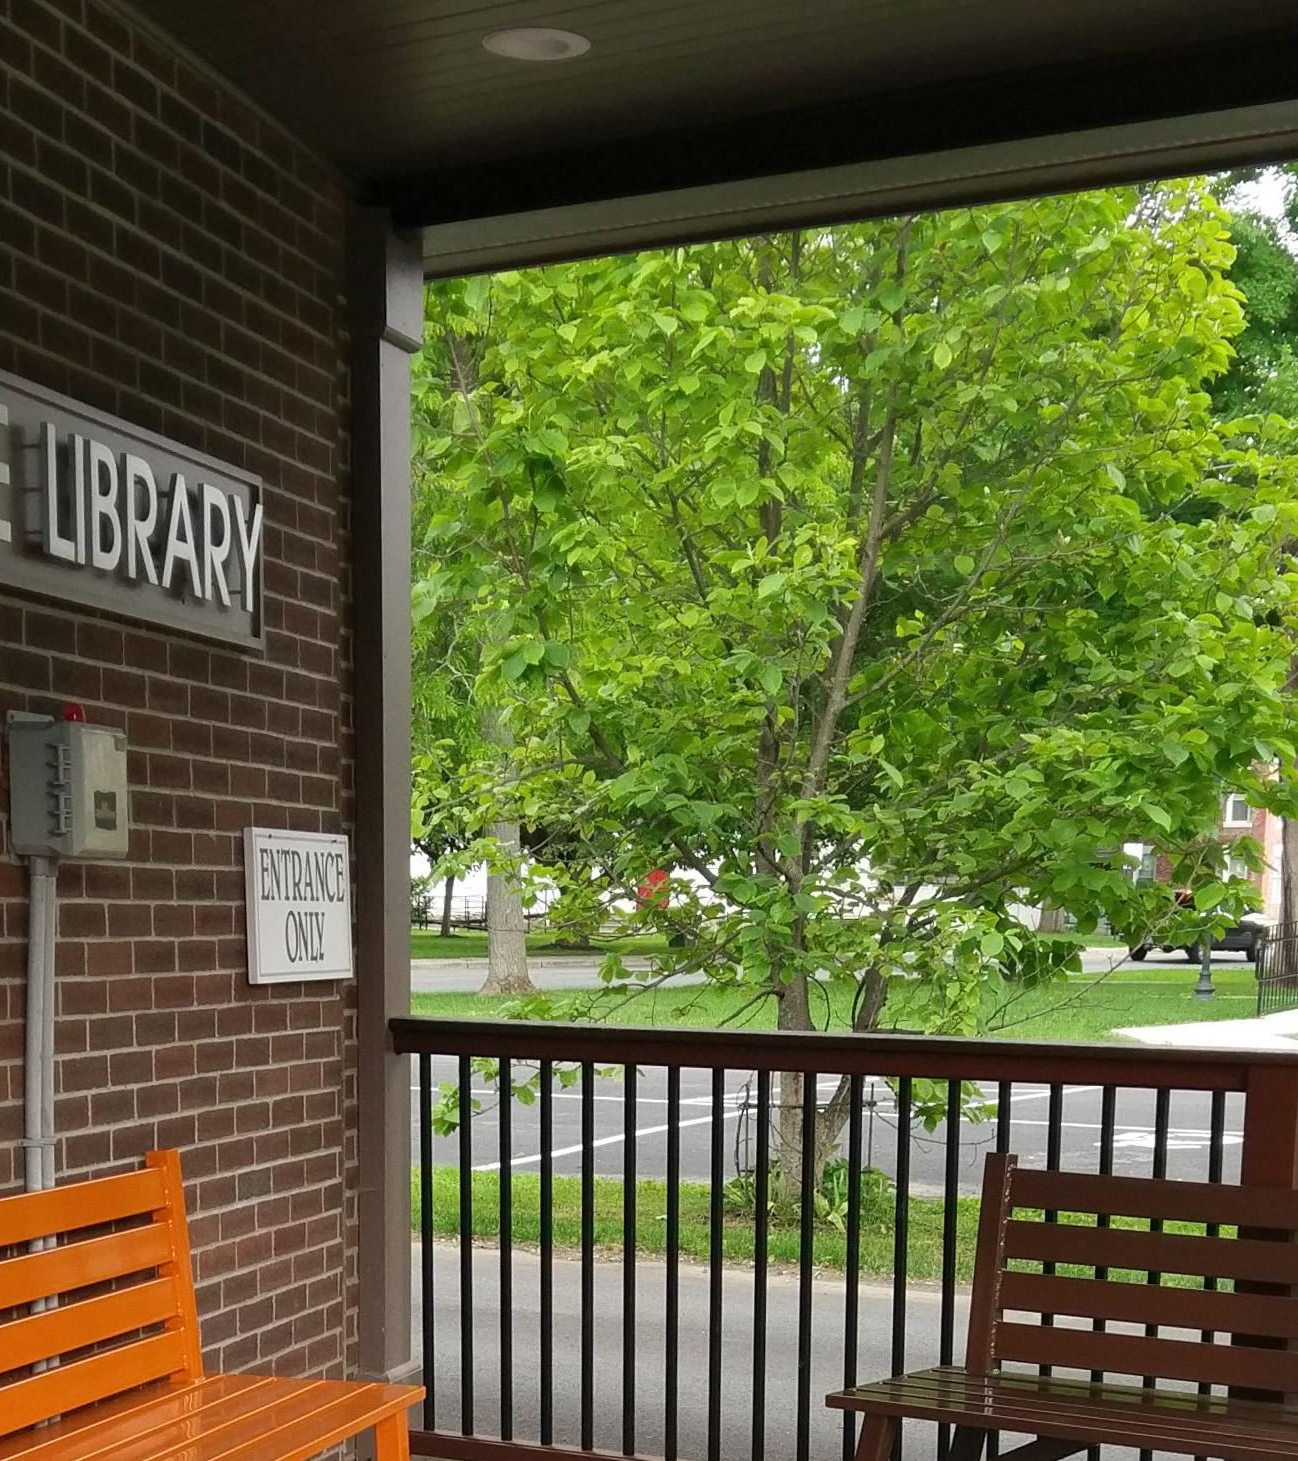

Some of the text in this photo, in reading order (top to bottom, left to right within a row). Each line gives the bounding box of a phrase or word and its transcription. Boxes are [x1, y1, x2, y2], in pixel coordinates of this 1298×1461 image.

[41, 421, 263, 612] LIBRARY
[259, 848, 345, 902] ENTRANCE
[285, 911, 325, 963] ONLY
